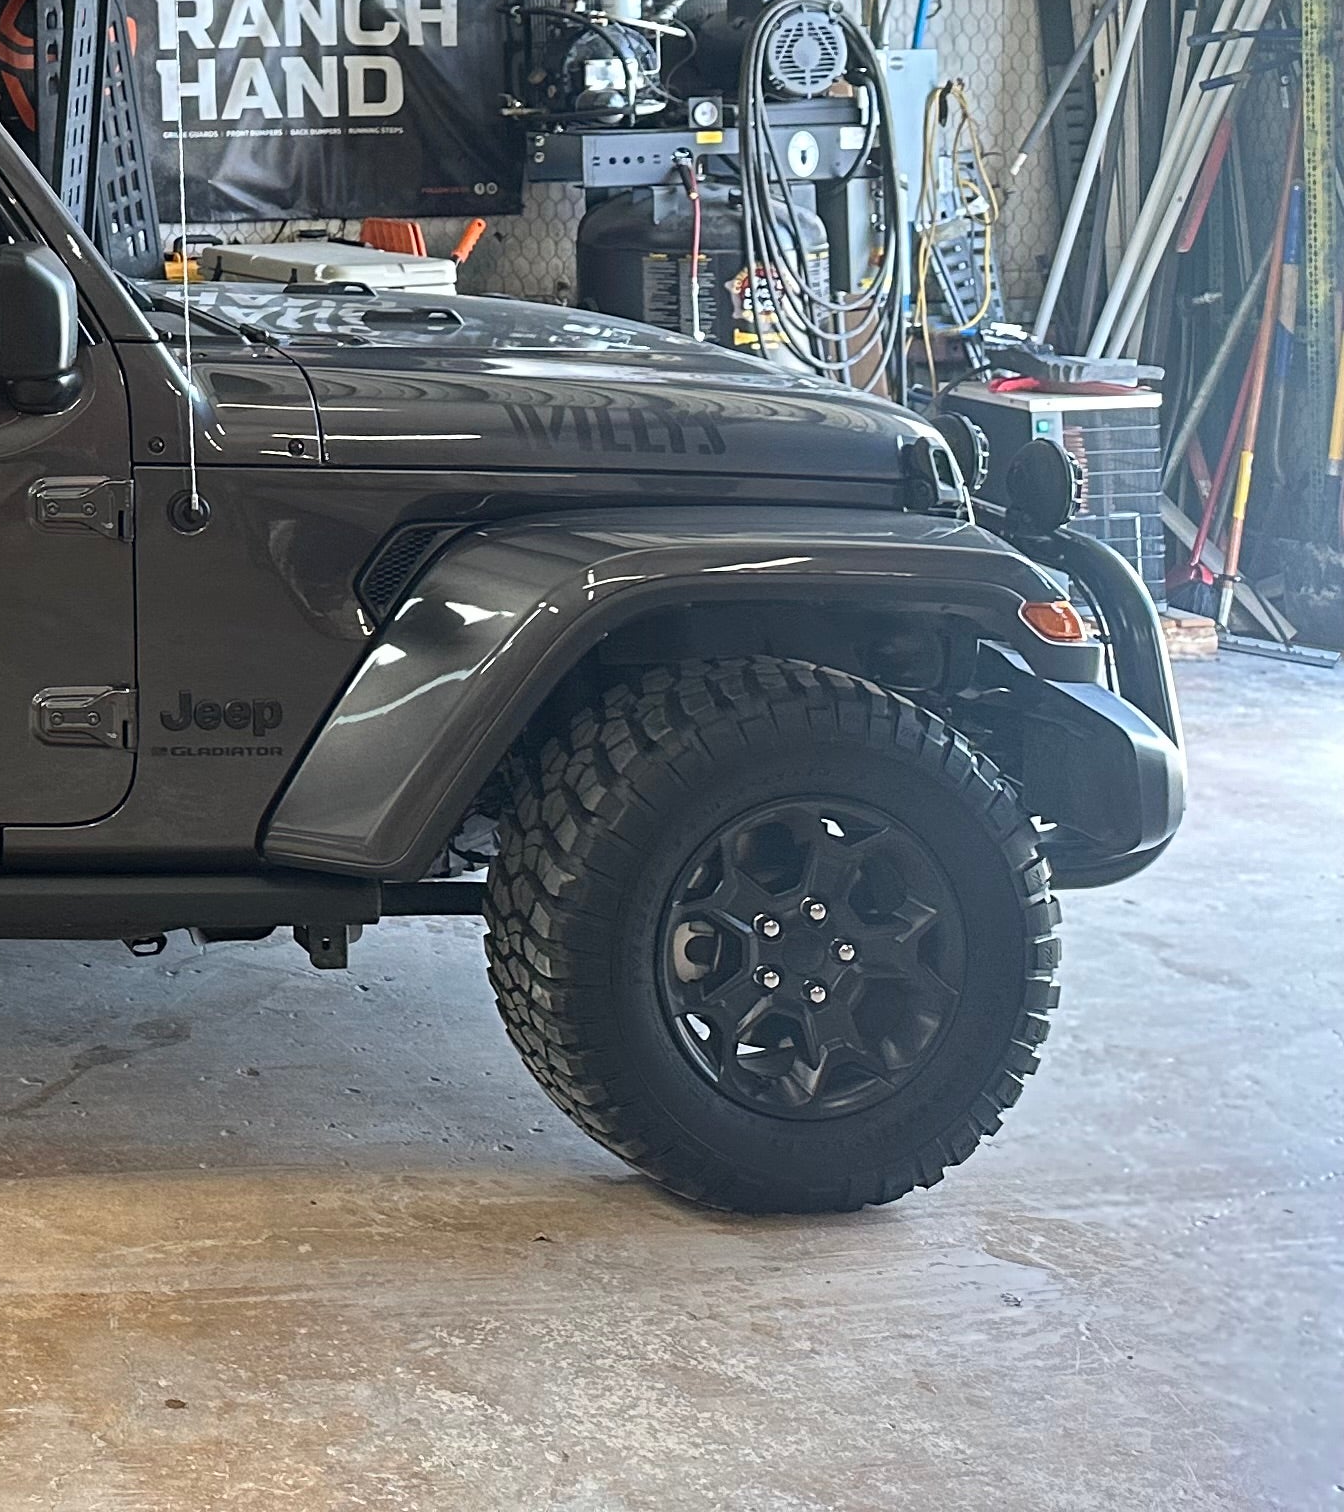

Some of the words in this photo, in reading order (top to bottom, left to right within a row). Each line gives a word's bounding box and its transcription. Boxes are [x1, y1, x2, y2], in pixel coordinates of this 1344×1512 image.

[156, 55, 404, 121] HAND
[502, 403, 726, 455] WILLYS
[160, 690, 283, 737] Jeep
[170, 746, 283, 757] GLADIATOR
